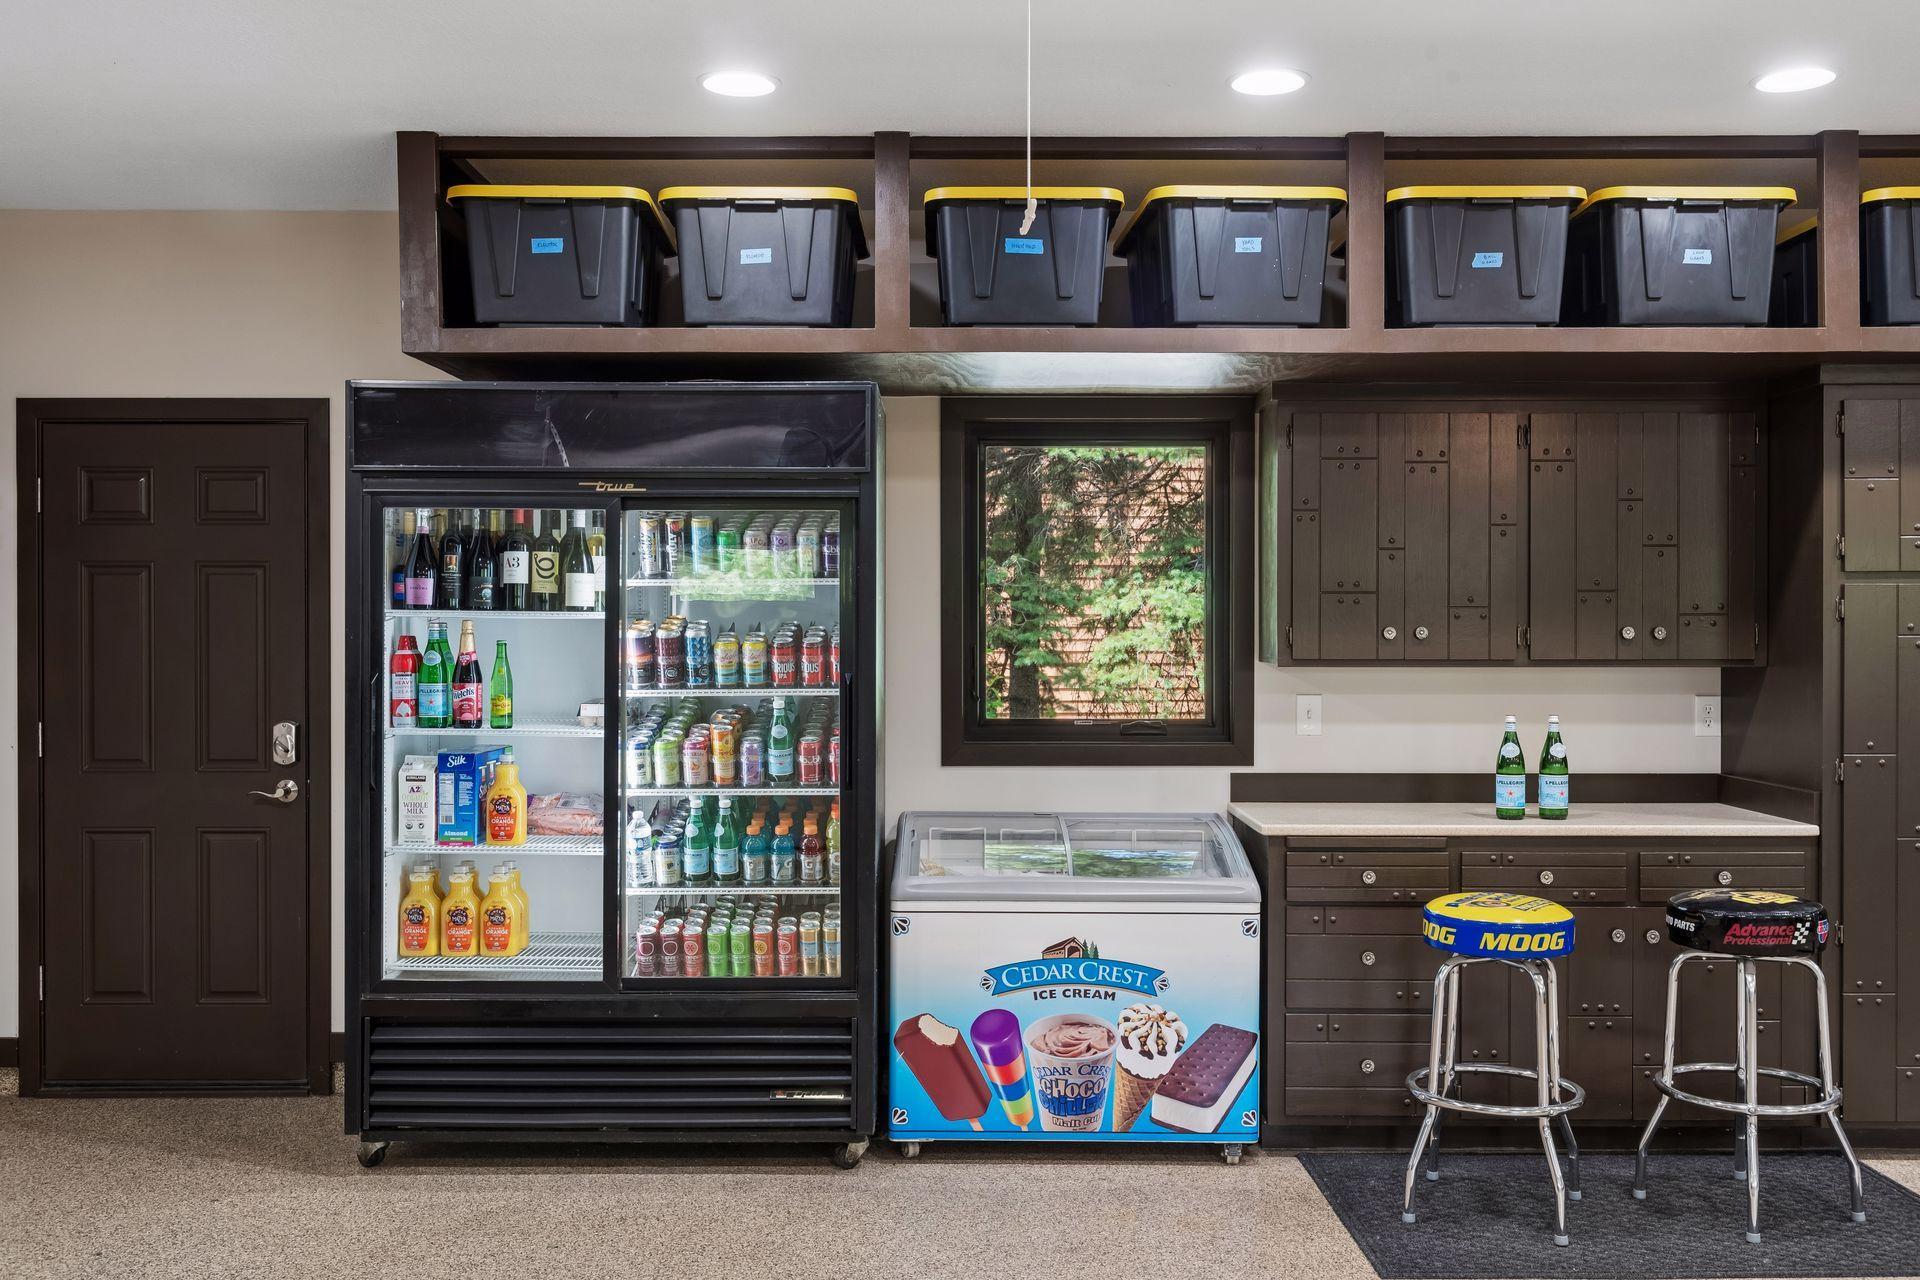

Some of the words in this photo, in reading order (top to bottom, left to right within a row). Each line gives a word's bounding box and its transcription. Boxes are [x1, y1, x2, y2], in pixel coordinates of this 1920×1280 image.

[447, 755, 467, 768] Silk
[1673, 918, 1696, 932] PARTS
[1726, 923, 1795, 936] Advance
[1479, 931, 1566, 952] MOOG
[1723, 935, 1793, 946] Professional
[1001, 963, 1076, 988] CEDAR
[1078, 961, 1149, 987] CREST
[1033, 989, 1057, 1001] ICE
[1062, 988, 1116, 1001] CREAM
[1078, 1064, 1110, 1078] CRES
[1040, 1077, 1106, 1099] CHOCO
[1052, 1116, 1082, 1128] Malt
